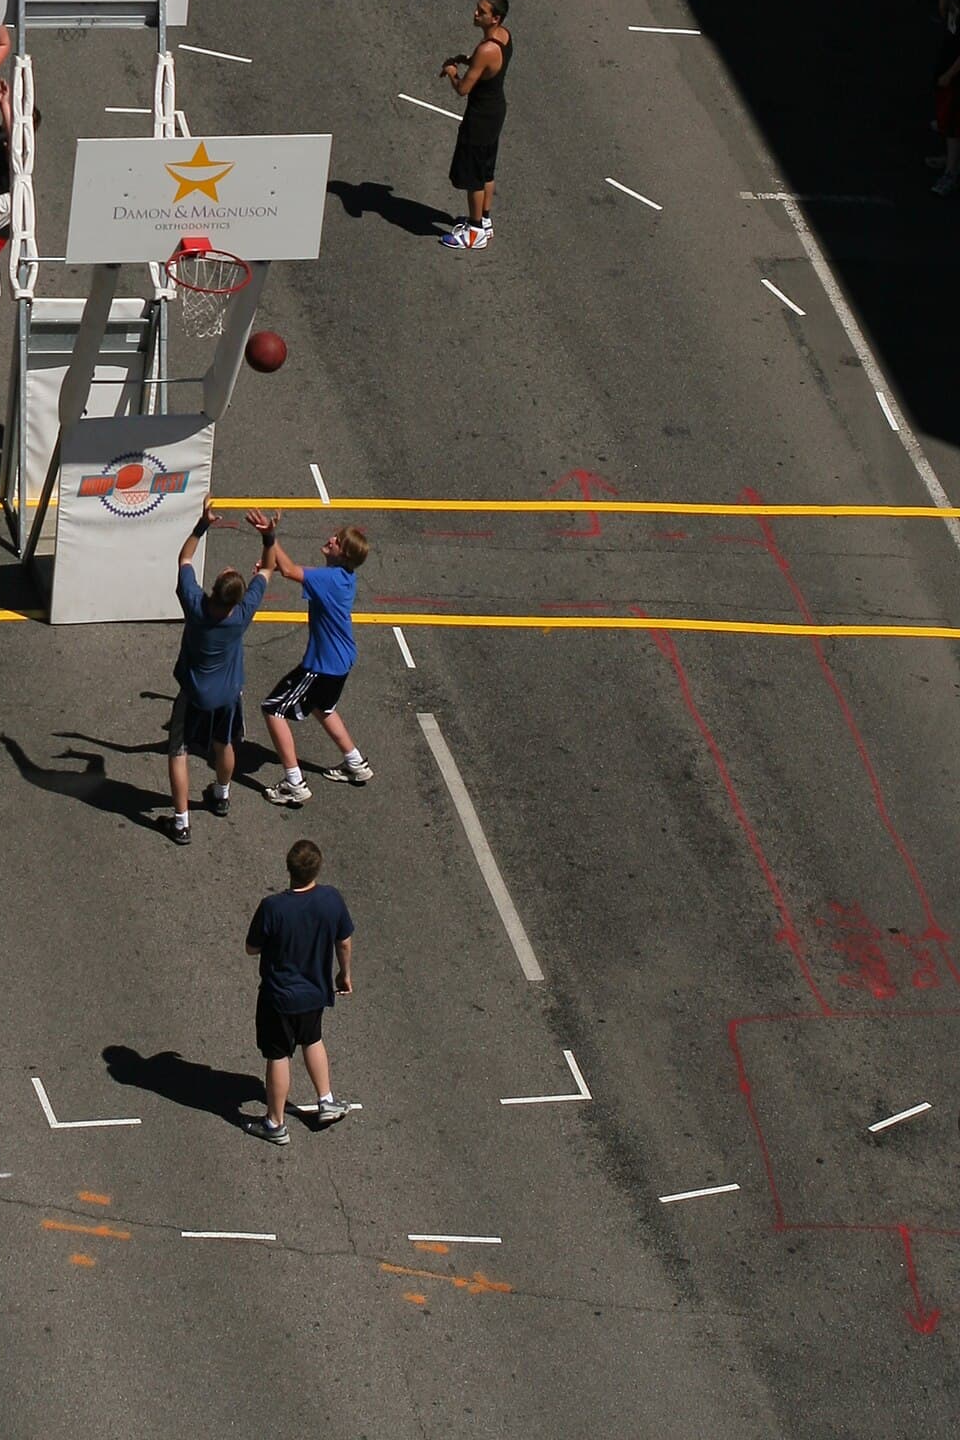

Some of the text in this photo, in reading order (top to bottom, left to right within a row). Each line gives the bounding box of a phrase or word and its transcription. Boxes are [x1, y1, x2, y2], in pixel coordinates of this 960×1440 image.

[113, 205, 279, 220] DAMON & MAGNUSON
[154, 222, 231, 232] ORTHODONTICS
[153, 473, 185, 493] FEST
